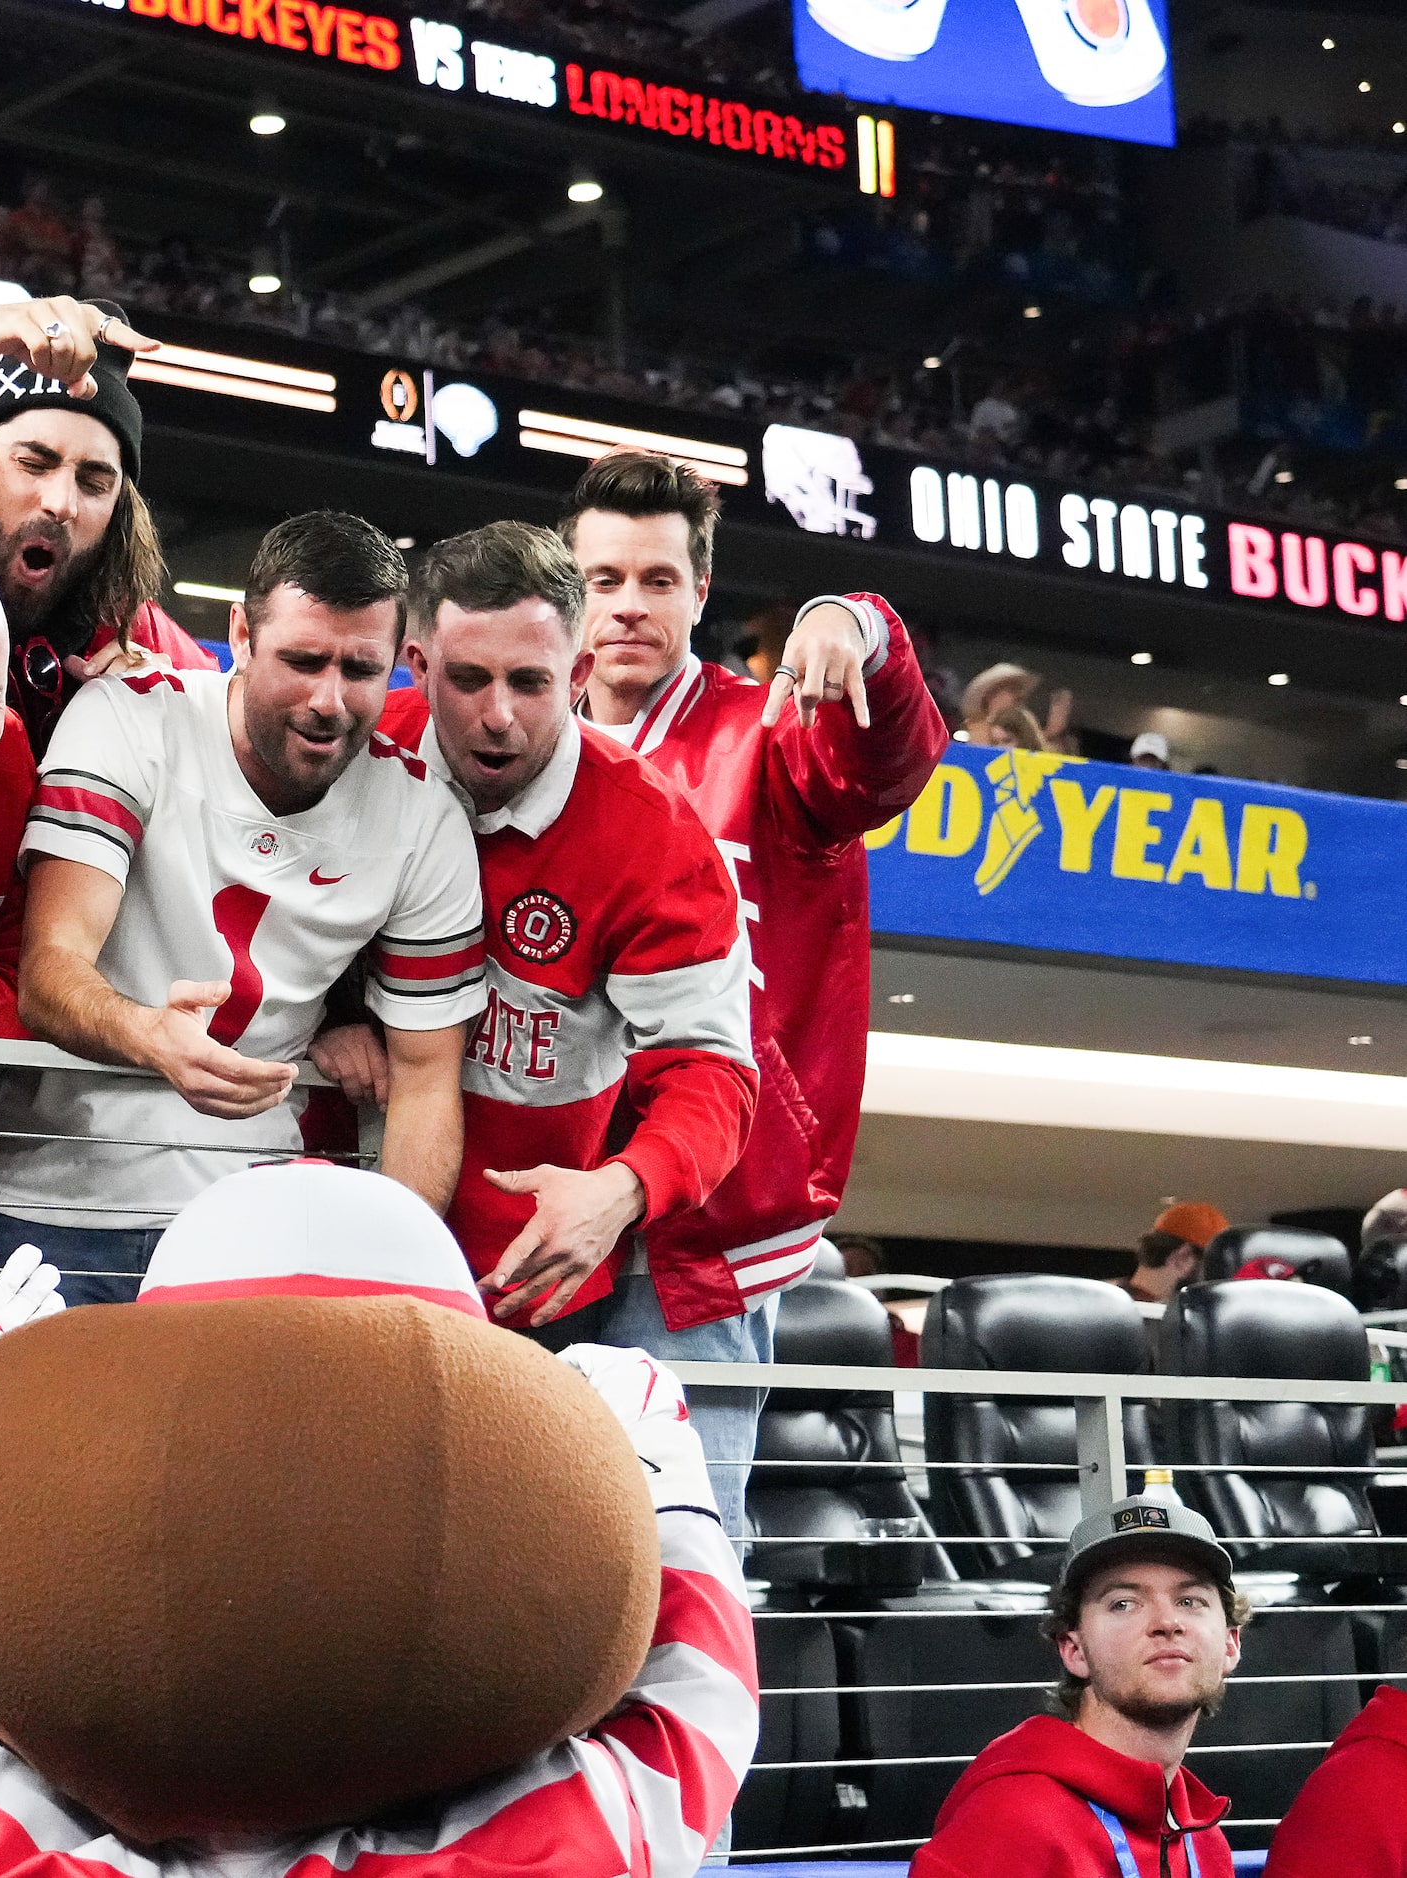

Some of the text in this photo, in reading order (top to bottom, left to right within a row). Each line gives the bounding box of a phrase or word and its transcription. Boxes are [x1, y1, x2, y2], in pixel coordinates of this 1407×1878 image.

[410, 17, 464, 91] VS
[565, 63, 846, 170] LONGHORNS
[909, 466, 1039, 559] OHIO
[1059, 493, 1209, 589] STATE
[506, 910, 517, 934] OHIO
[517, 895, 550, 909] STATE
[465, 984, 562, 1081] ATE
